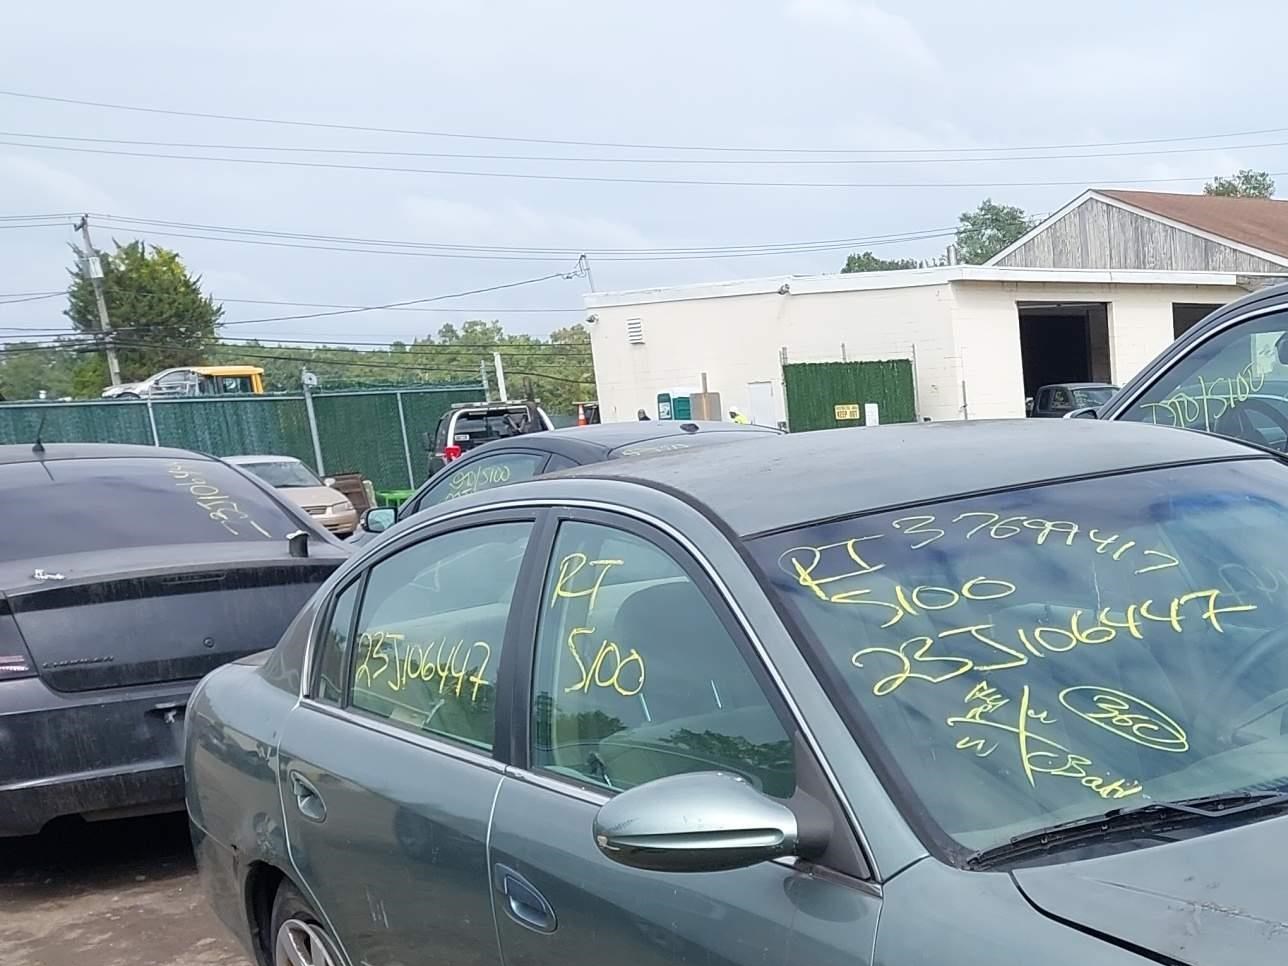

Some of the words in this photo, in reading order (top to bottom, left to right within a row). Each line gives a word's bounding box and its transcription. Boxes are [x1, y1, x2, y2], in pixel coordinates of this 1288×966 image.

[551, 552, 625, 618] RT
[355, 631, 493, 702] 23J106447
[852, 589, 1258, 696] 23J106447
